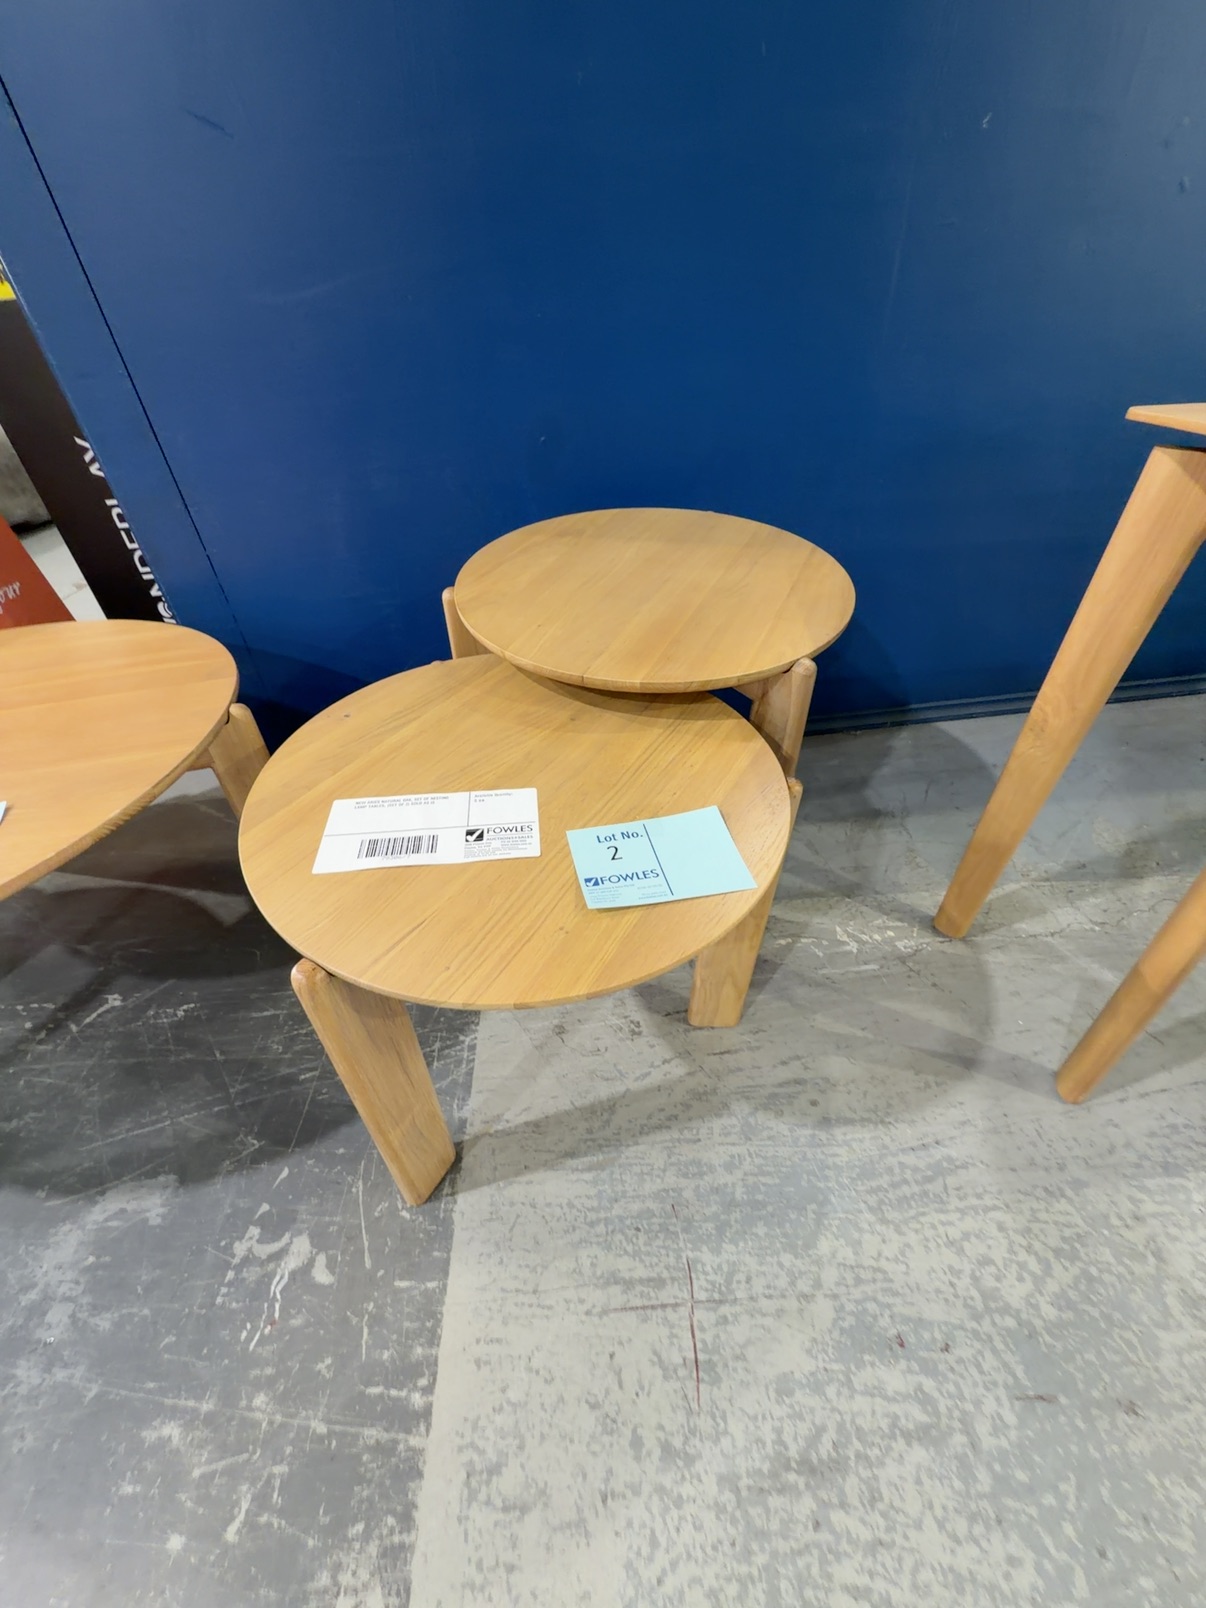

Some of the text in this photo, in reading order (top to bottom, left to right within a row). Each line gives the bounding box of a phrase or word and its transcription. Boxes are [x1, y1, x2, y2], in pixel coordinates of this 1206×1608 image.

[486, 824, 533, 834] FOWLES
[596, 830, 644, 844] Lot No.
[606, 845, 623, 861] 2
[599, 868, 660, 885] FOWLES
